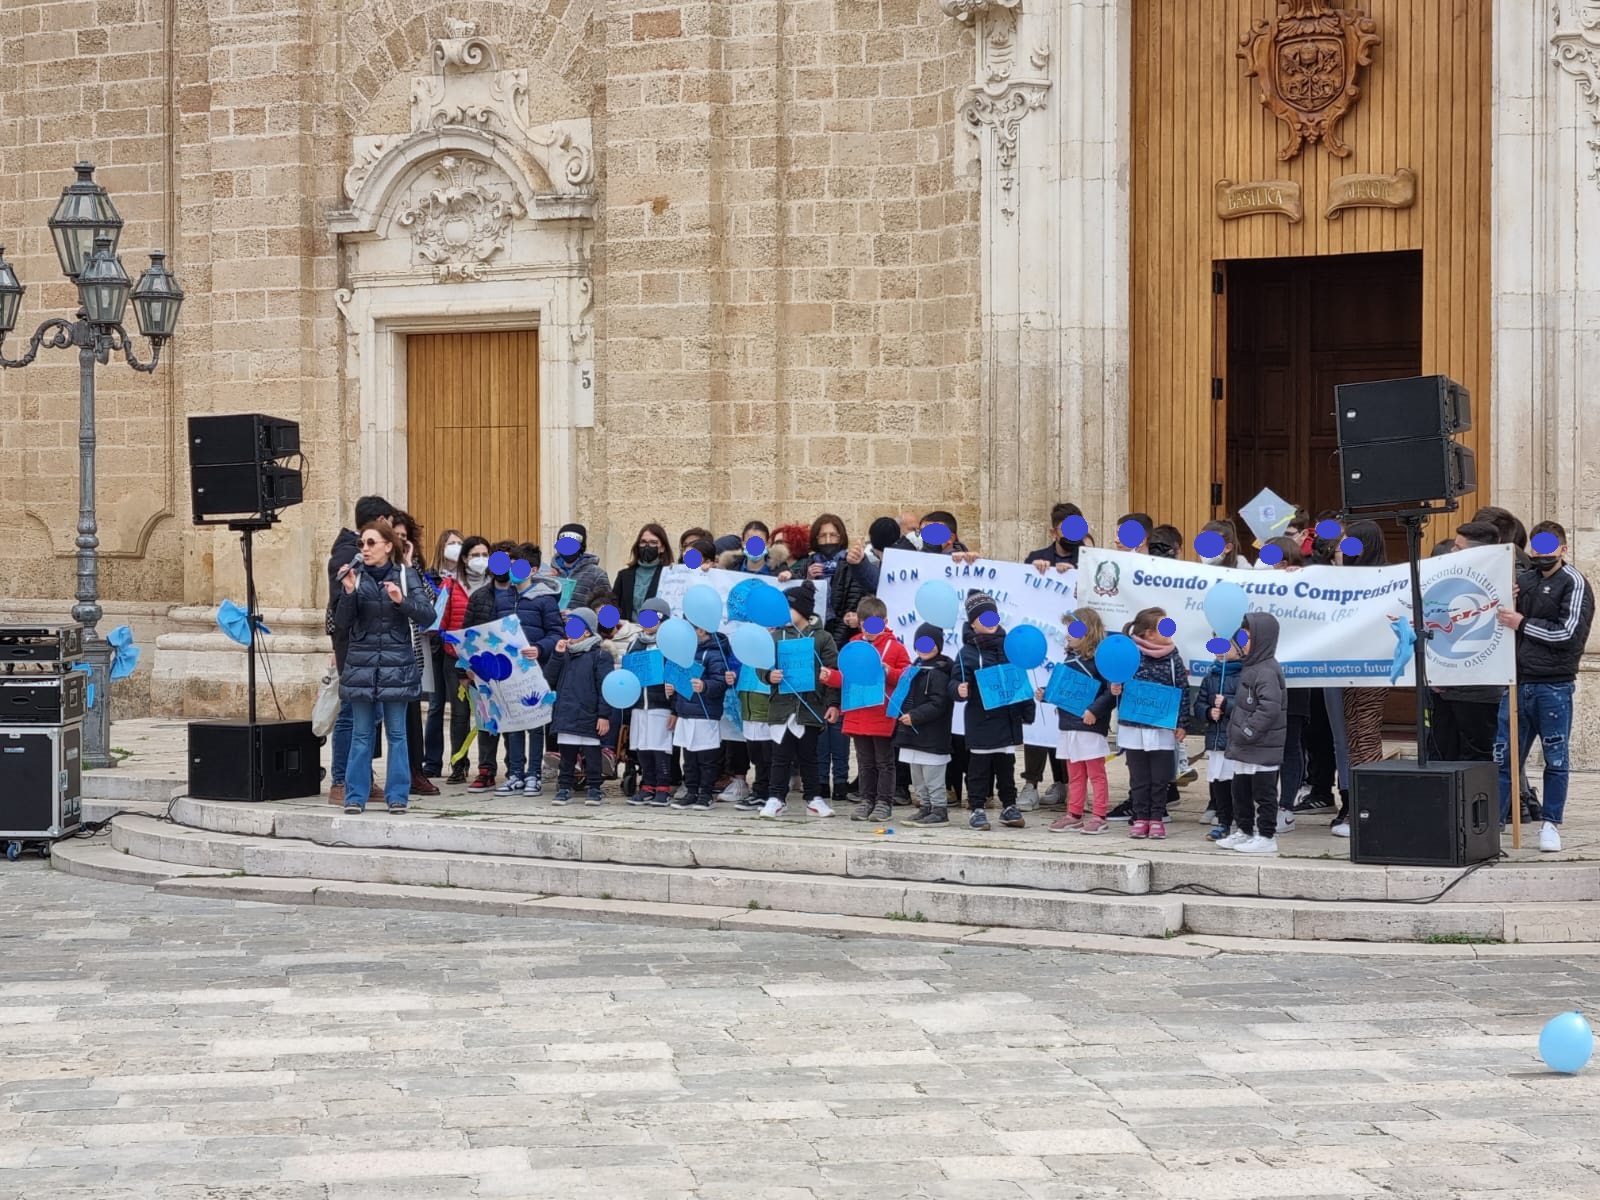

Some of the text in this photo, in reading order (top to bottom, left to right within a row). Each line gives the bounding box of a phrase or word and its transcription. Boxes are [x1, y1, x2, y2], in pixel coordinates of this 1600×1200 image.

[1228, 187, 1283, 209] BASILICA
[581, 369, 592, 390] 5
[887, 566, 1070, 596] NON SIAMO TUTTI
[1132, 569, 1208, 590] Secondo
[1294, 578, 1409, 605] Comprensivo
[1466, 565, 1500, 602] Istituto
[1312, 663, 1328, 674] nel
[1329, 664, 1362, 674] vostro
[1363, 661, 1393, 673] futur
